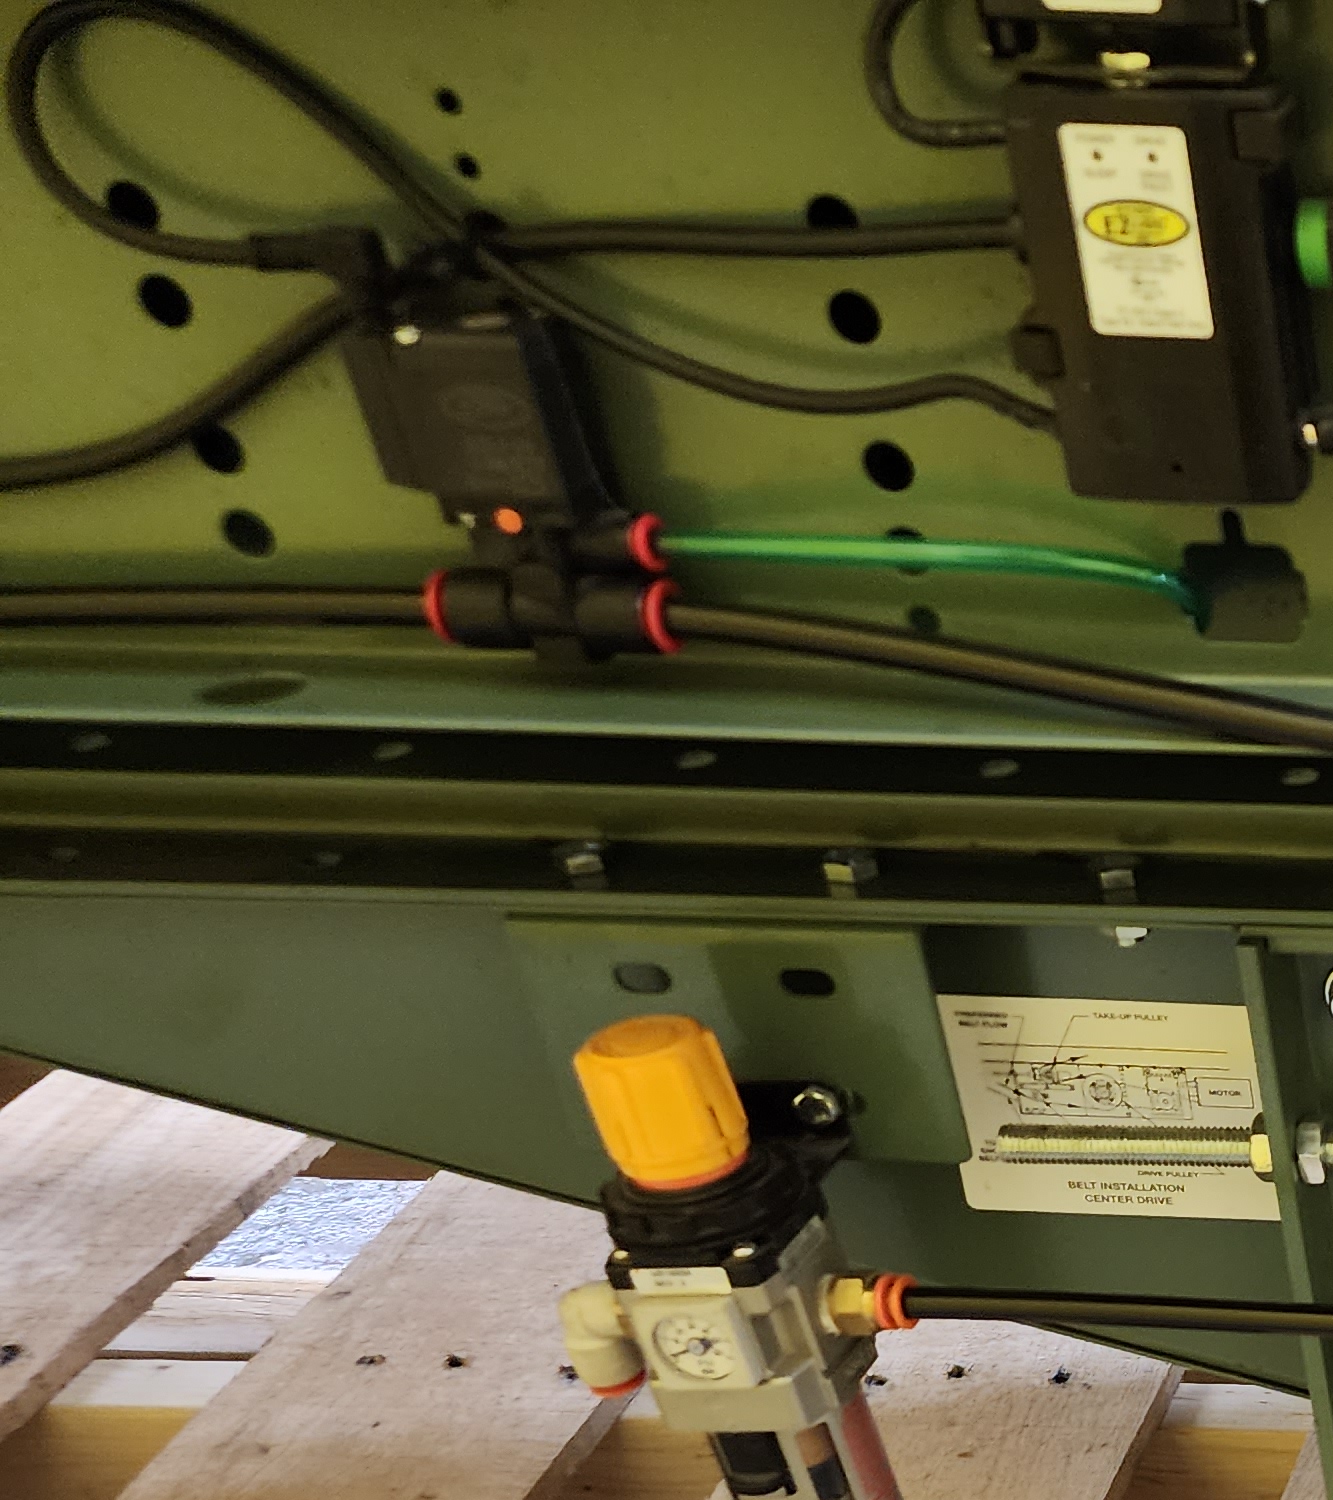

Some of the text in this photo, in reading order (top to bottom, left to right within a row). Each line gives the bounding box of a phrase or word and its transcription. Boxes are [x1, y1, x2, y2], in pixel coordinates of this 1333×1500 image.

[1209, 1089, 1241, 1097] MOTOR
[1067, 1180, 1185, 1193] BELT INSTALLATION
[1084, 1194, 1173, 1205] CENTER DRIVE
